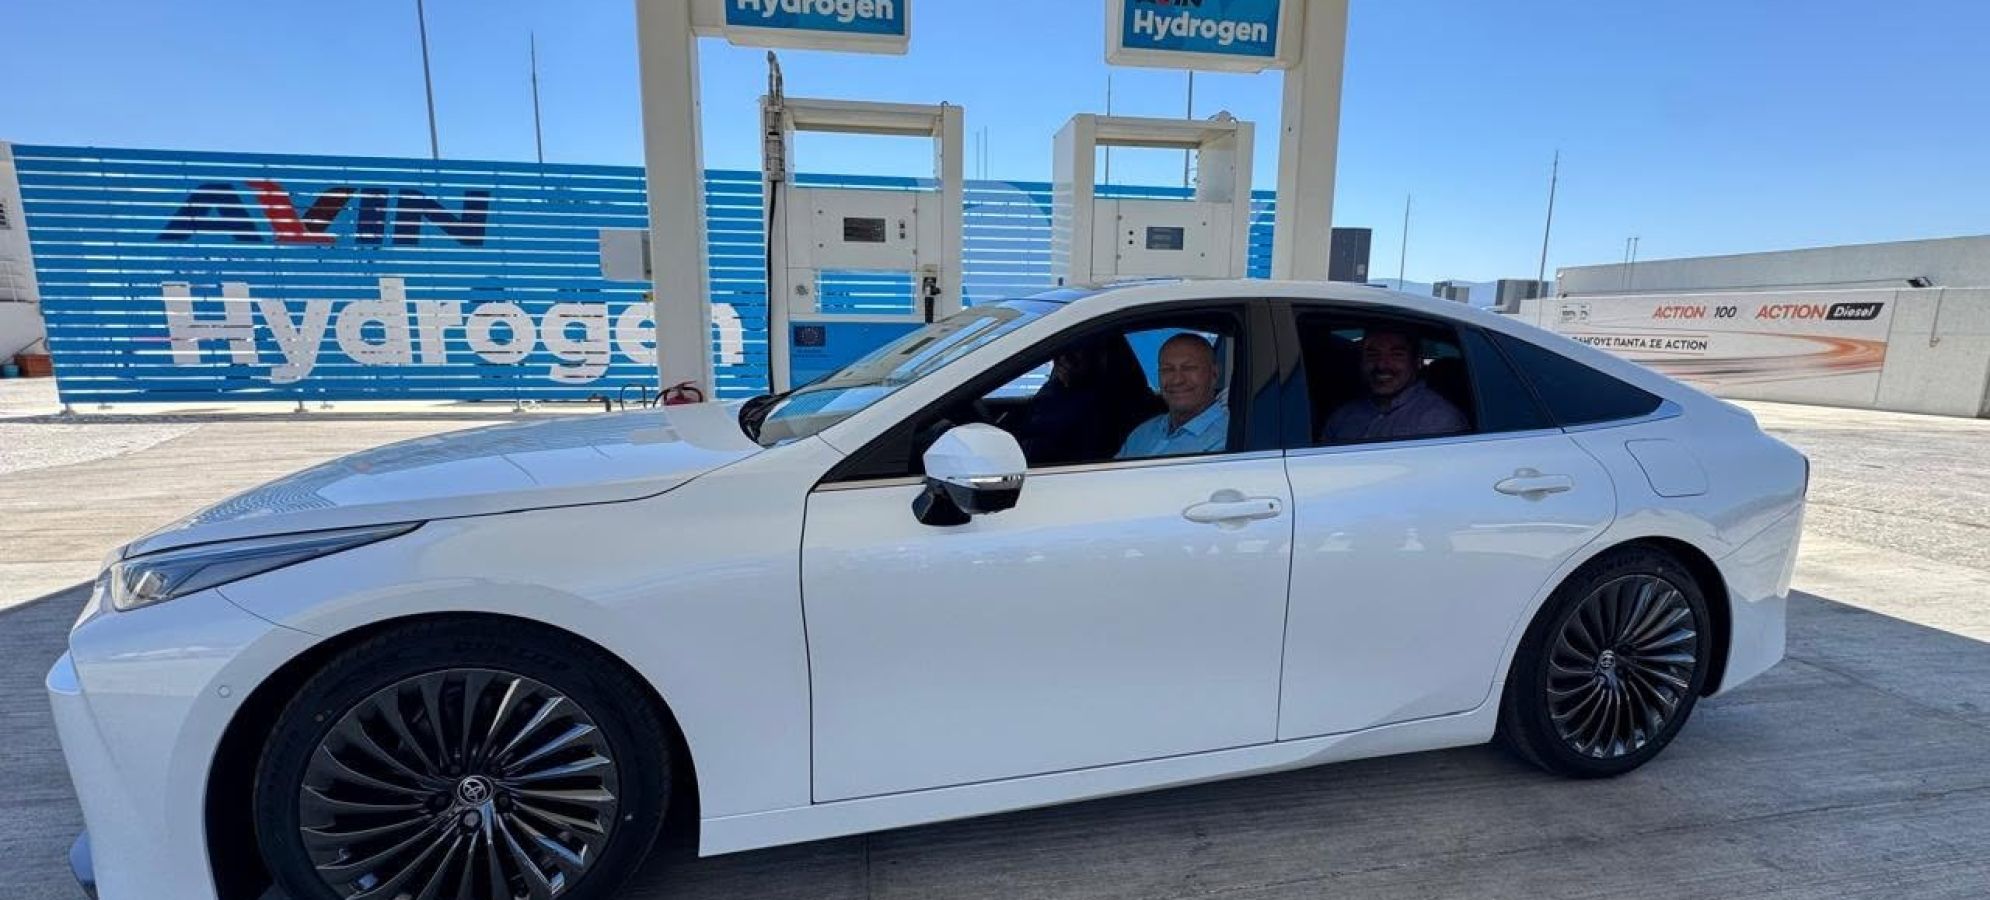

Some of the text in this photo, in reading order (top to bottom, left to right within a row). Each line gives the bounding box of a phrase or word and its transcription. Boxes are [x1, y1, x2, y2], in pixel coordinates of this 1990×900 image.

[1133, 8, 1268, 46] Hydrogen
[156, 180, 490, 247] AVIN
[1652, 306, 1738, 320] ACTION 100
[1755, 305, 1876, 320] ACTION Diesel
[161, 278, 744, 384] Hydrogen
[1572, 336, 1609, 347] ΗΓΟΥΣ
[1614, 337, 1647, 348] ΠΑΝΤΑ
[1665, 339, 1708, 351] ACTION
